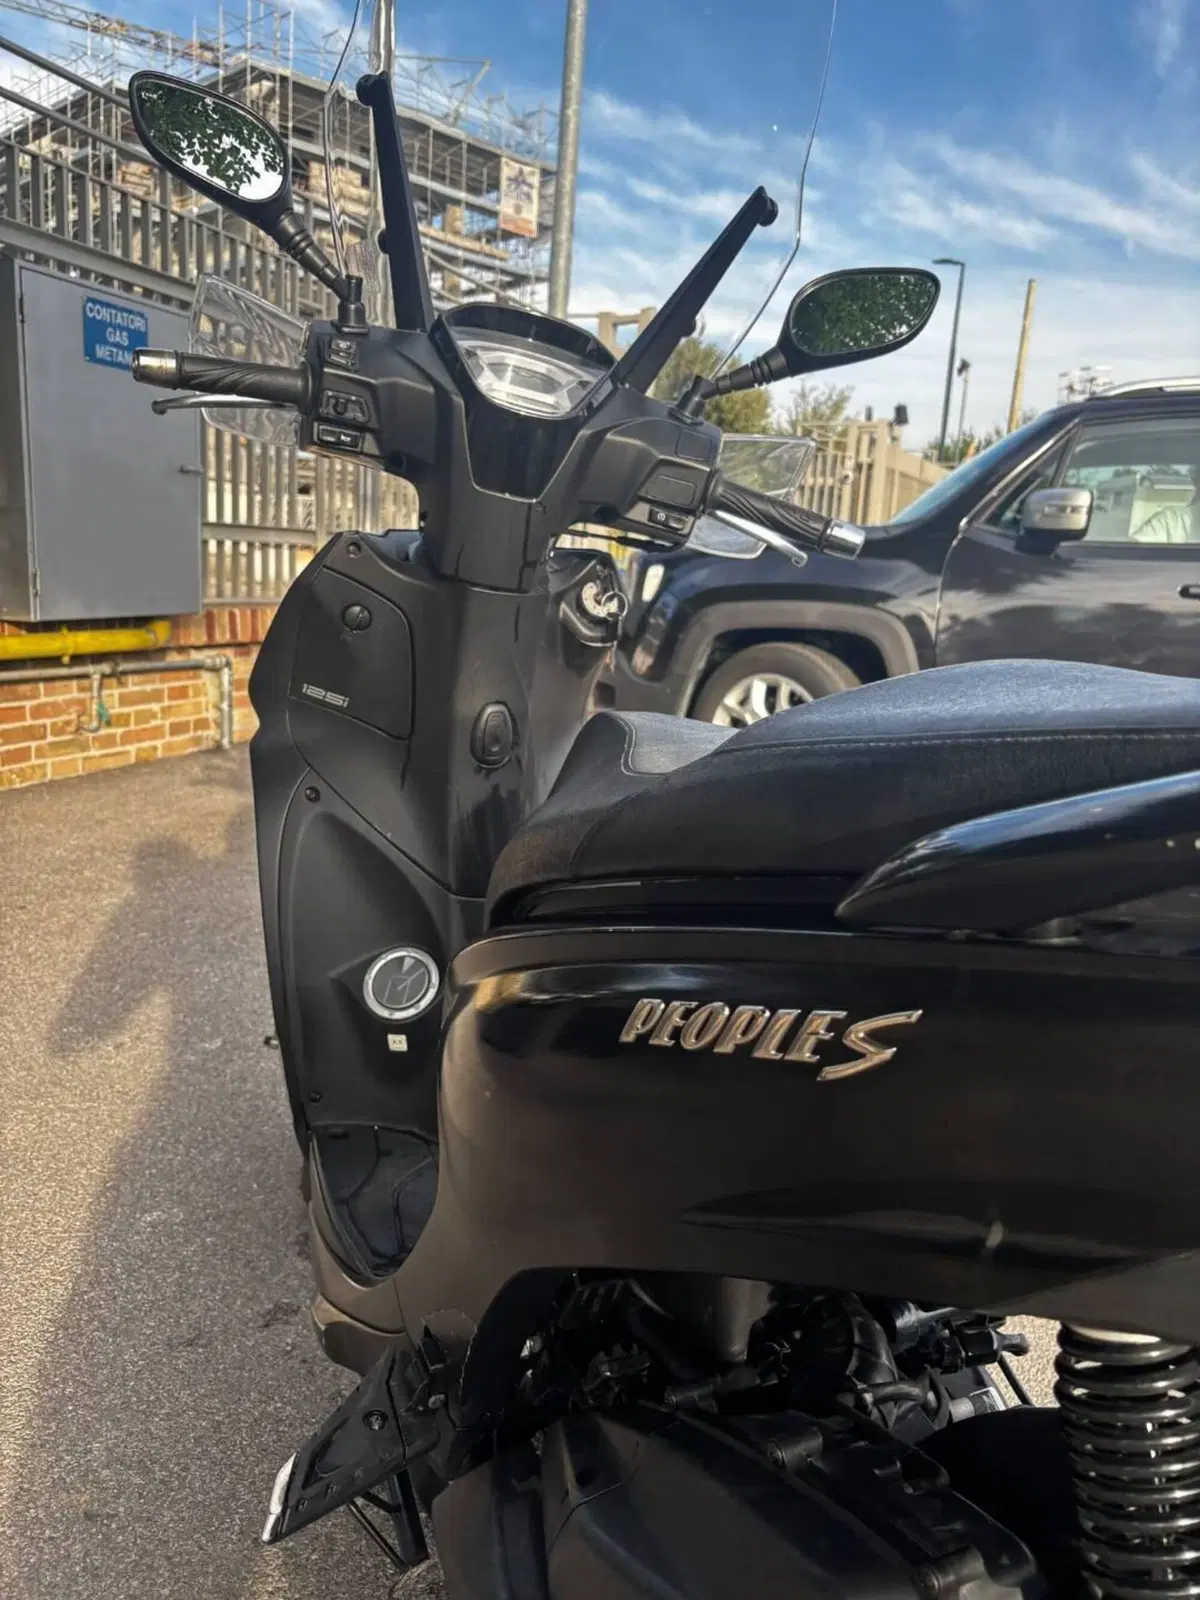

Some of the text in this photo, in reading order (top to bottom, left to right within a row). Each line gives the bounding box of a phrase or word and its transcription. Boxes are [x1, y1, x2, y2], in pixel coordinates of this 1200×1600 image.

[85, 302, 146, 332] CONTATORI
[106, 327, 129, 346] GAS
[95, 344, 133, 365] METAN
[302, 683, 349, 707] 125i
